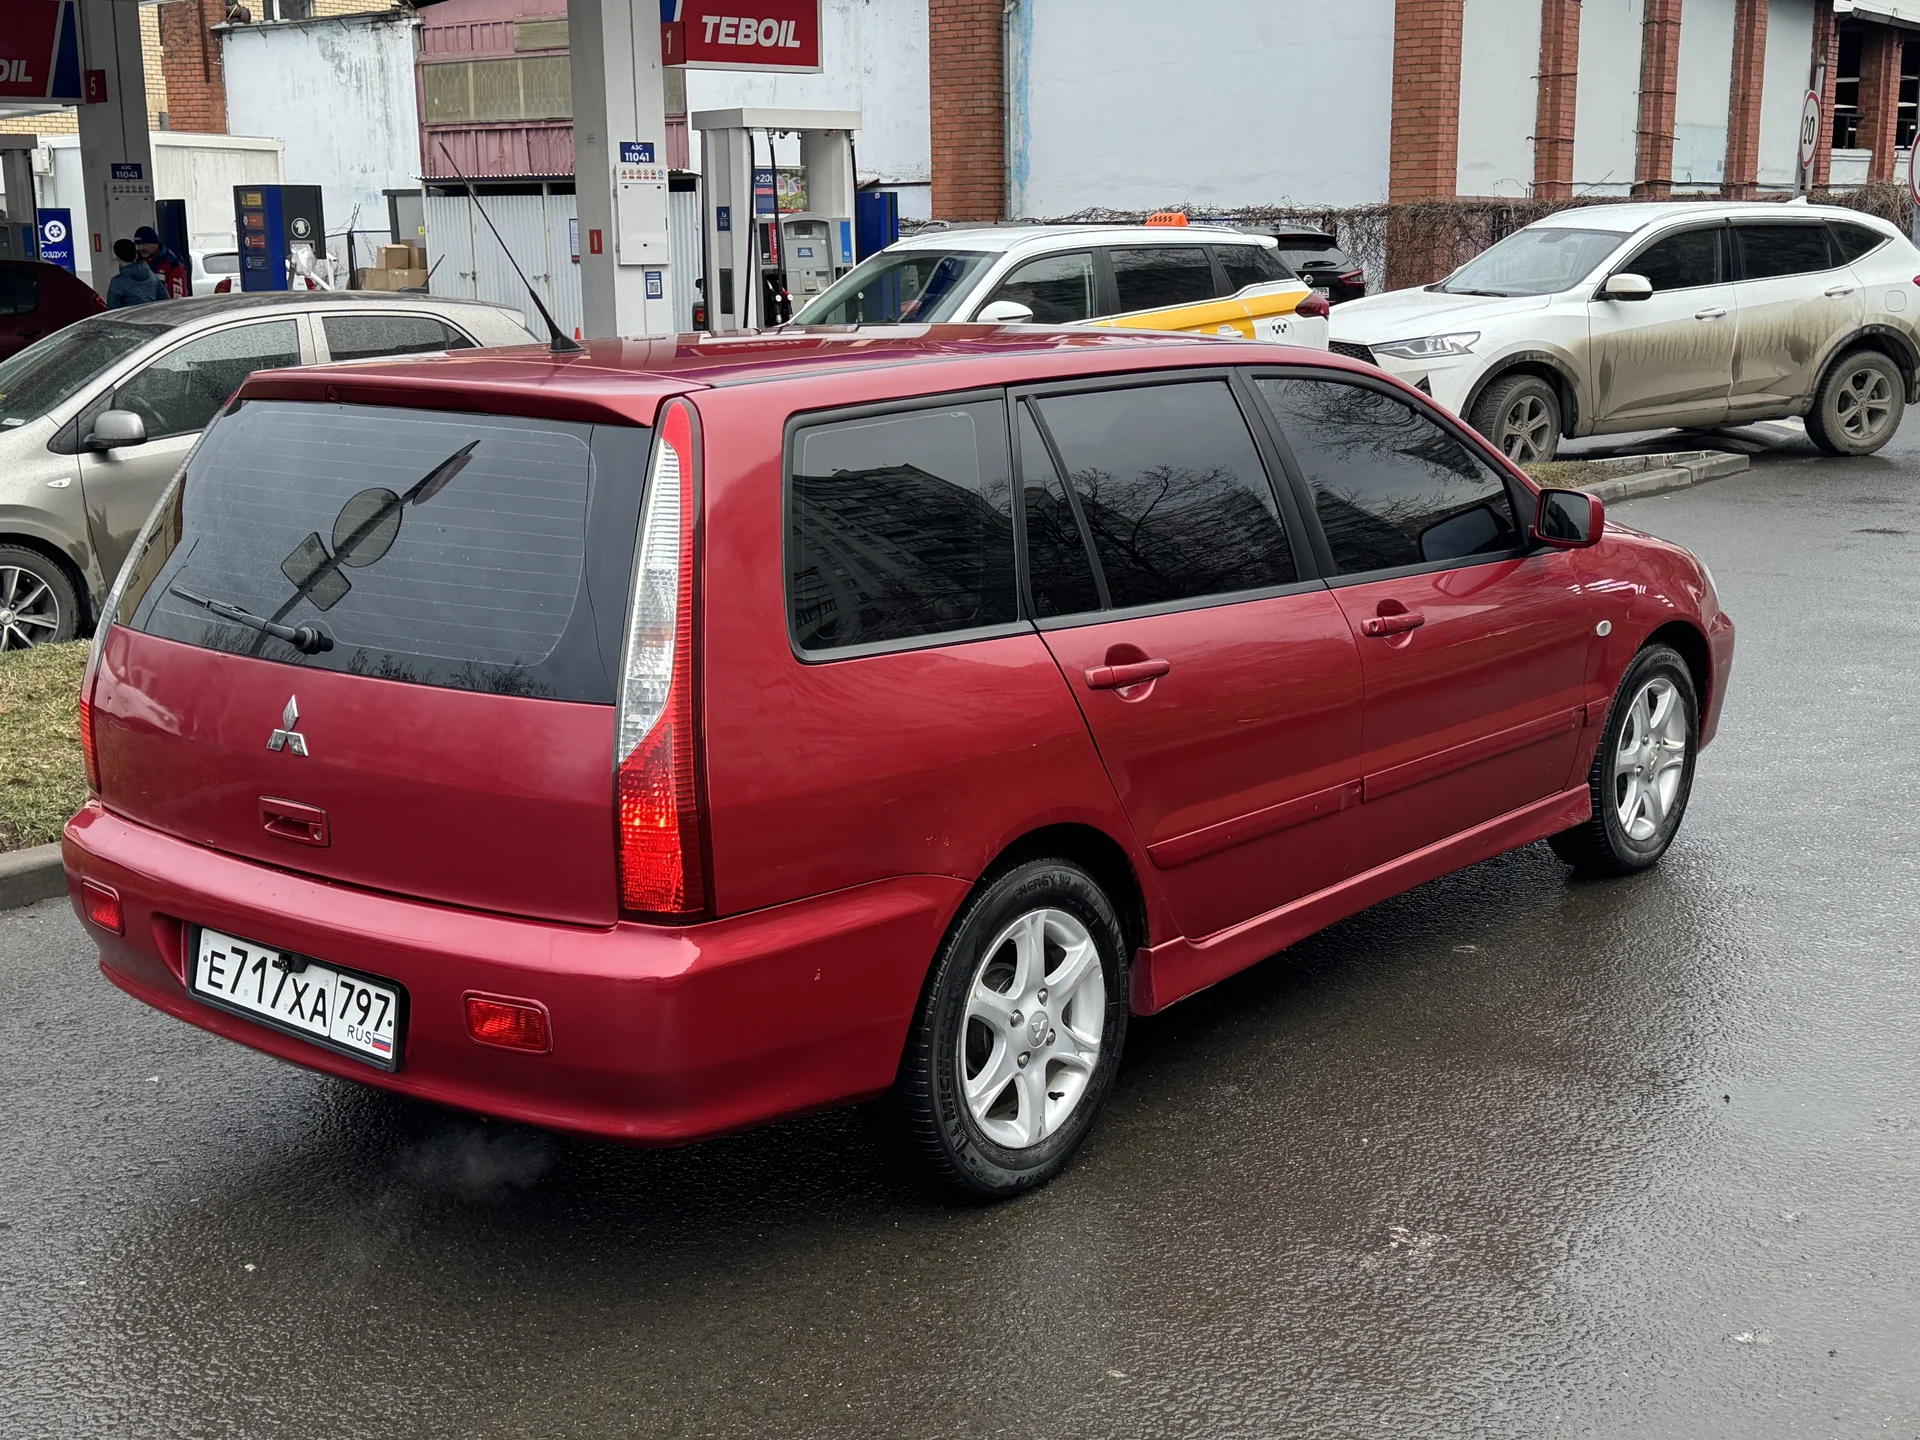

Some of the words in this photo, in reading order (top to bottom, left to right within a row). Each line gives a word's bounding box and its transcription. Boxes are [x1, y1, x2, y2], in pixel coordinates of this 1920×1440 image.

[666, 29, 672, 54] 1
[702, 15, 800, 48] TEBOIL
[90, 77, 97, 96] 5
[1803, 115, 1815, 145] 20
[624, 152, 650, 162] 11041
[115, 171, 138, 179] 11041
[338, 980, 390, 1032] 797
[346, 1025, 372, 1045] RUS
